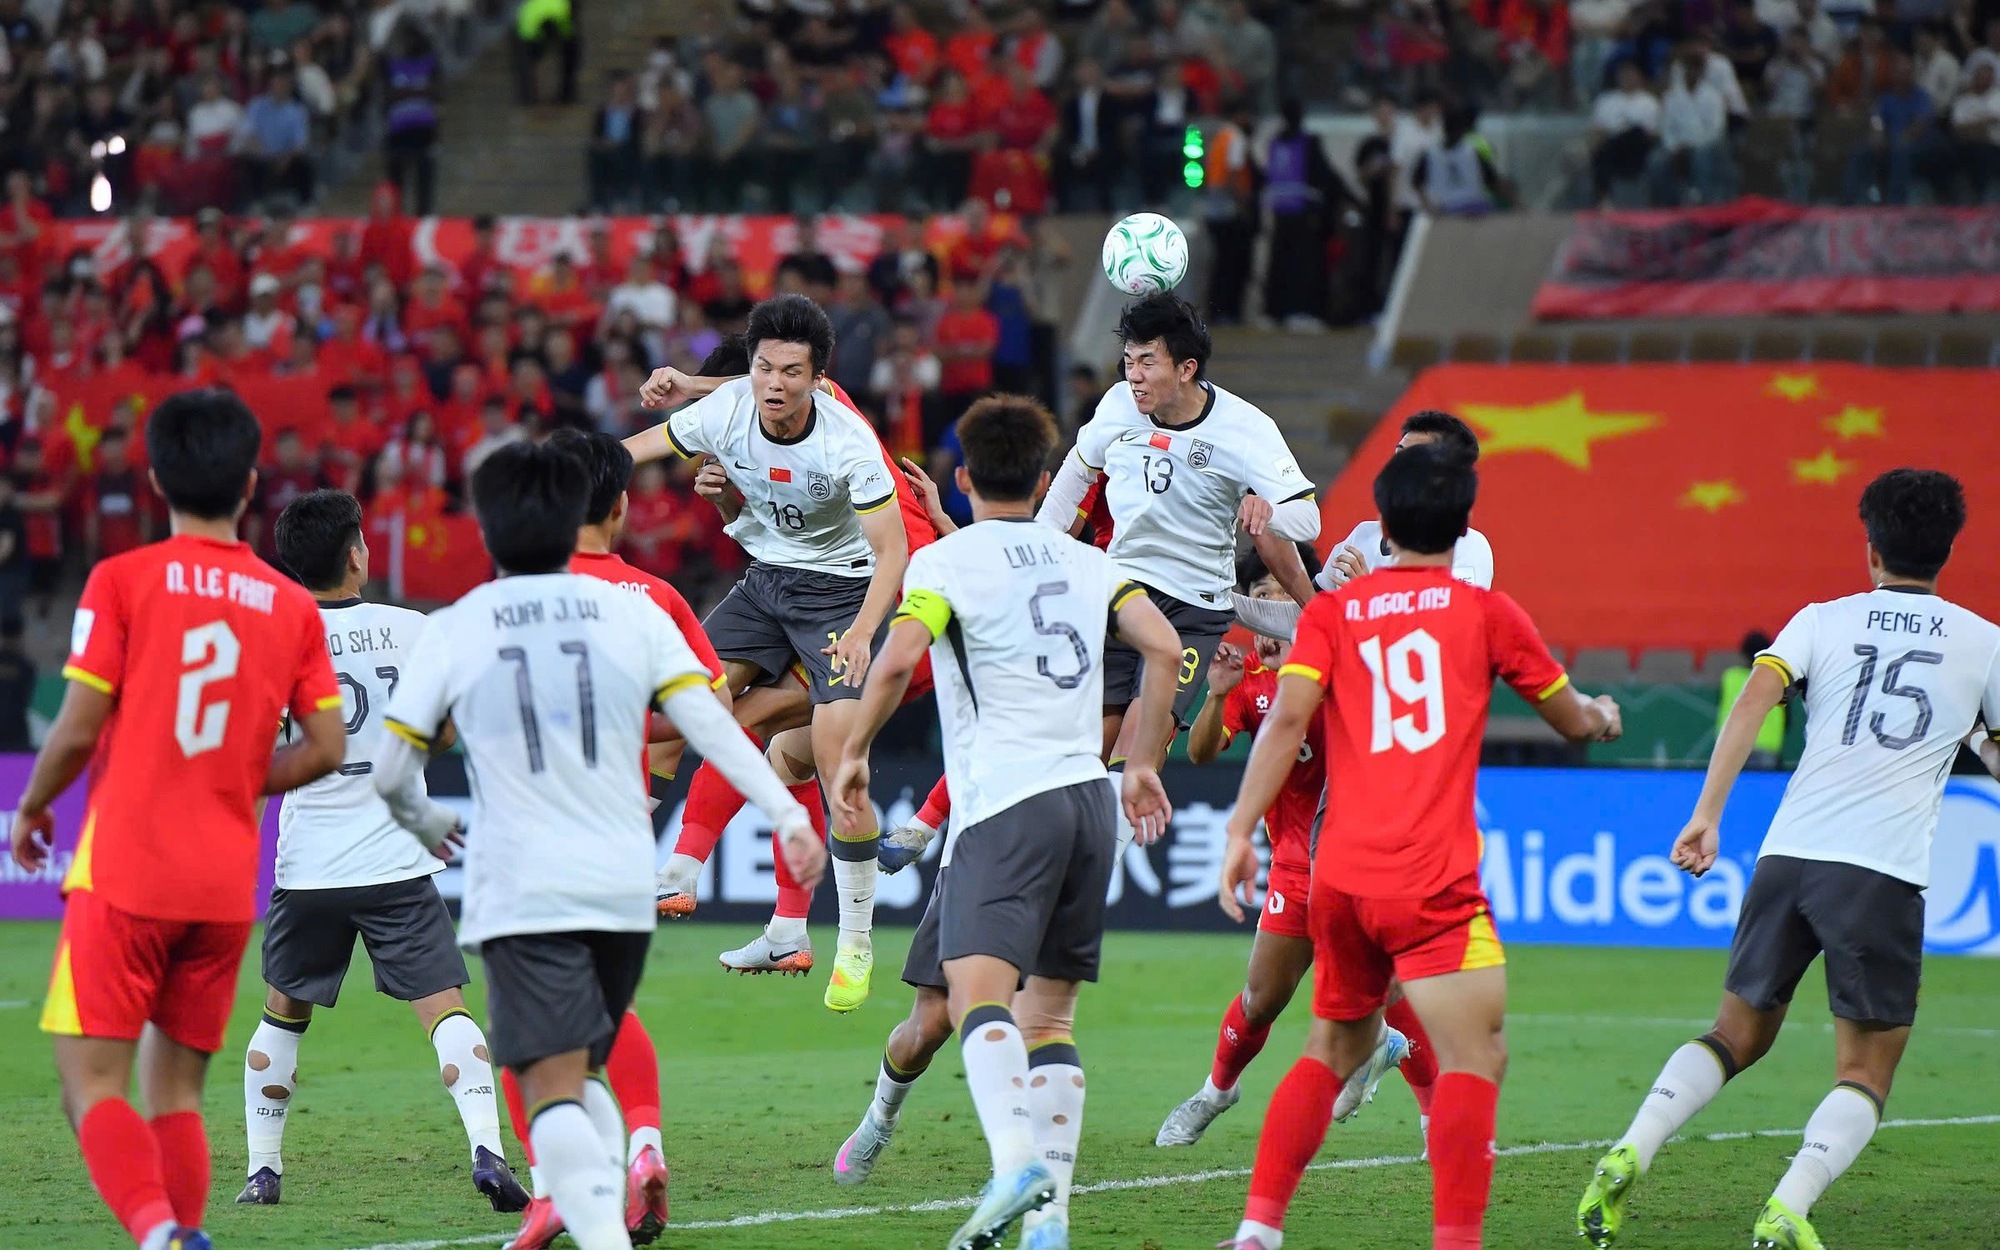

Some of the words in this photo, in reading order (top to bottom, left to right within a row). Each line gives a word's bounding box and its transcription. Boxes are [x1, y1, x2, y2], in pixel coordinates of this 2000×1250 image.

[1143, 455, 1174, 494] 13
[768, 501, 806, 530] 18
[1004, 544, 1036, 568] LIU
[194, 564, 224, 598] LE
[493, 600, 545, 629] KUAI
[1866, 610, 1922, 634] PENG
[1929, 616, 1948, 637] X.
[1028, 580, 1091, 690] 5
[175, 620, 241, 758] 2
[499, 641, 598, 774] 11
[1358, 627, 1447, 754] 19
[1841, 643, 1944, 751] 15
